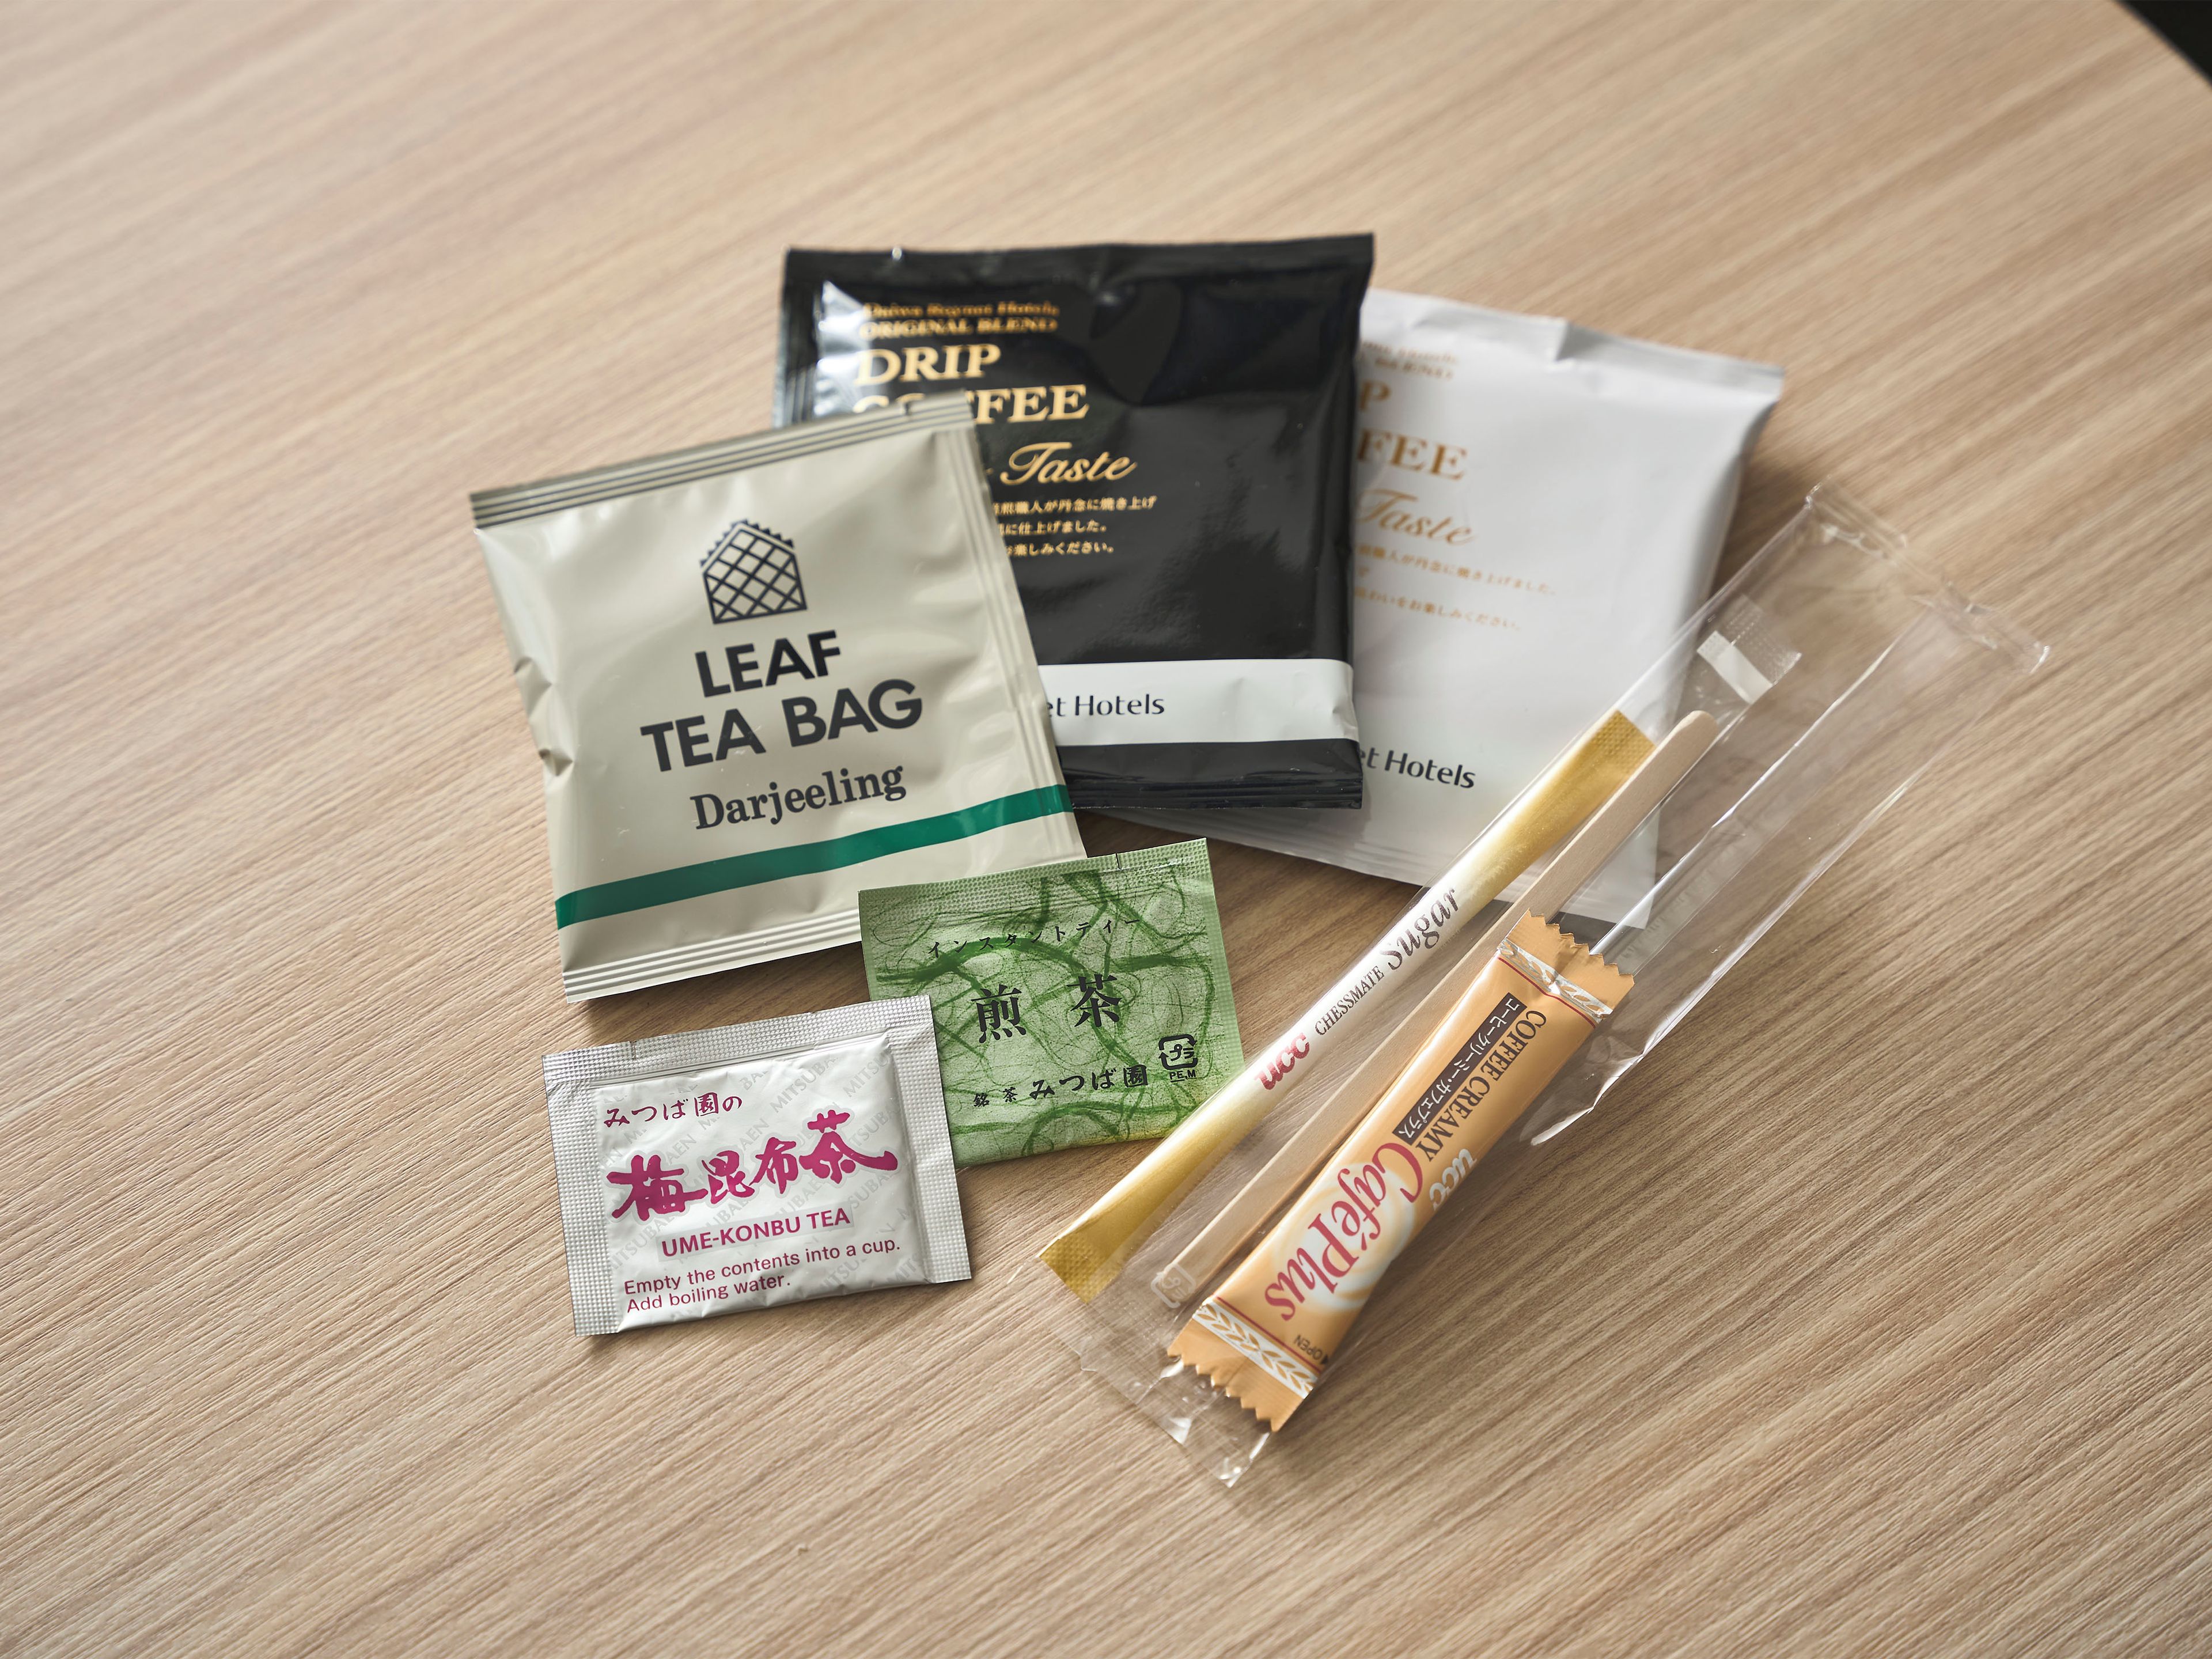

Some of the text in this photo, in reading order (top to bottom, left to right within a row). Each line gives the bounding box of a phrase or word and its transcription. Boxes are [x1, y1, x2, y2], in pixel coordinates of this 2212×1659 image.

[859, 317, 1058, 342] ORIGINAL BLEND
[853, 344, 1001, 386] DRIP
[1000, 441, 1138, 486] Taste
[1358, 488, 1476, 546] Taste
[695, 630, 841, 698] LEAF
[640, 679, 923, 772] TEA BAG
[1075, 693, 1165, 717] Hotels
[1384, 749, 1476, 789] Hotels
[690, 766, 907, 830] Darjeeling
[928, 919, 1141, 959] インスタントティー
[1314, 965, 1385, 1036] CHESSMATE
[1380, 888, 1459, 971] Sugar
[971, 974, 1122, 1043] 煎茶
[604, 1092, 743, 1128] みつば園の
[1415, 1010, 1547, 1162] COFFEE CREAMY
[606, 1109, 898, 1221] 梅昆布茶
[662, 1216, 801, 1257] UME-KONBU
[806, 1208, 851, 1229] TEA
[624, 1275, 681, 1294] Empty
[687, 1270, 715, 1285] the
[721, 1253, 800, 1277] contents
[805, 1246, 840, 1263] into
[846, 1245, 857, 1256] a
[862, 1239, 900, 1253] cup.
[627, 1275, 790, 1313] Add boiling water.
[1293, 1334, 1323, 1360] OPEN
